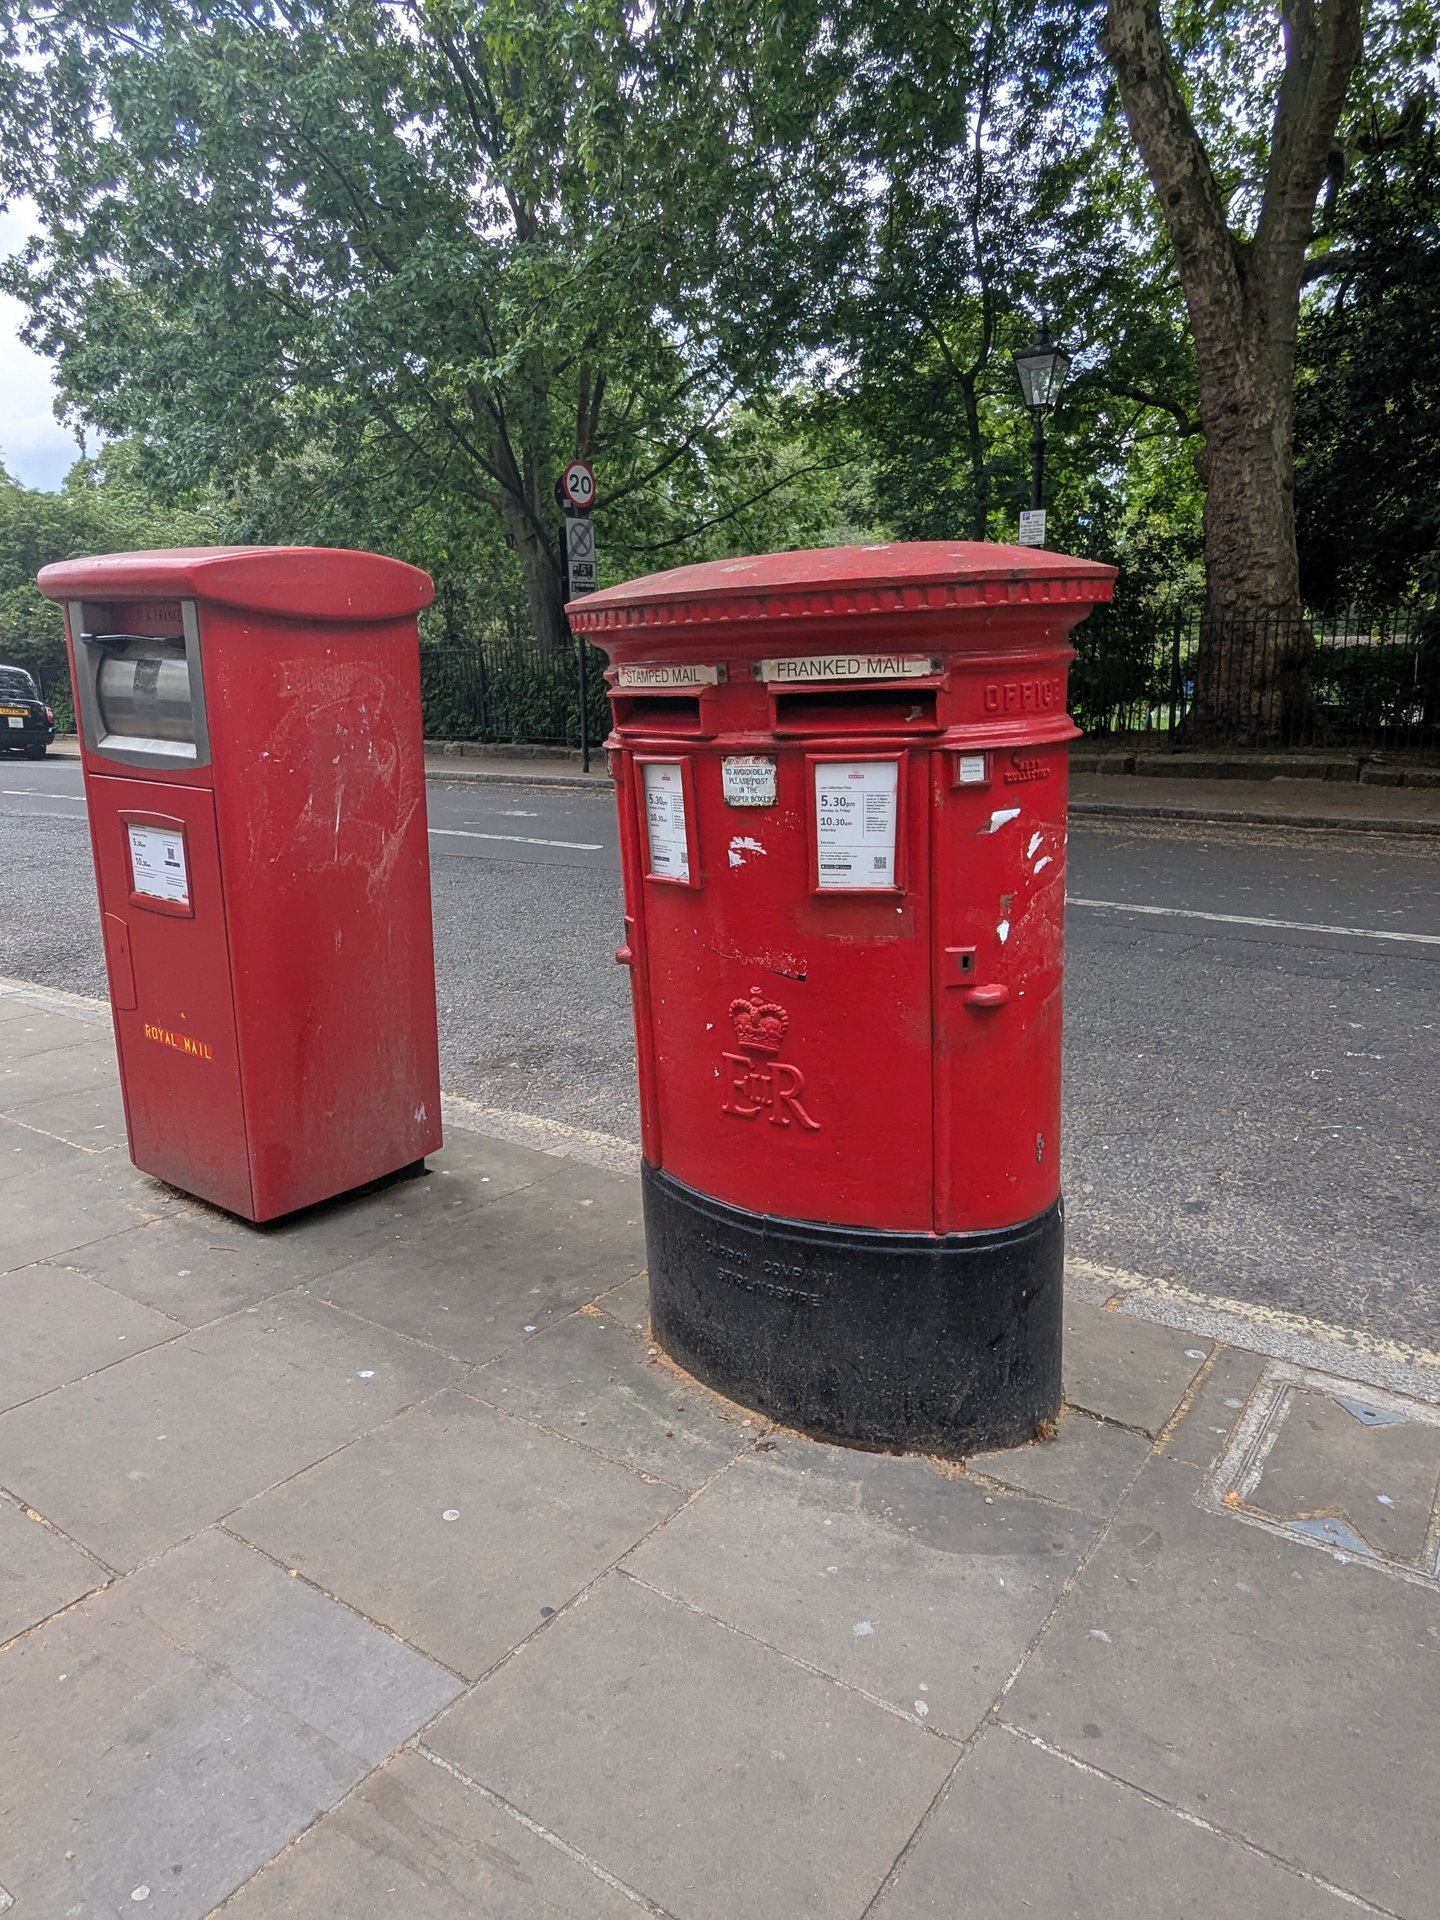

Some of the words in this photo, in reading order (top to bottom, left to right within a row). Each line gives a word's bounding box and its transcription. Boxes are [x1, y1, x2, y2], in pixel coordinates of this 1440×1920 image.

[569, 474, 592, 495] 20
[777, 658, 861, 678] FRANKED
[866, 657, 912, 674] MAIL
[626, 669, 669, 684] STAMPED
[672, 668, 701, 683] MAIL
[733, 768, 751, 776] AVOID
[752, 768, 773, 776] DELAY
[751, 795, 771, 803] BOXES
[821, 794, 856, 808] 5.30pm
[144, 1023, 178, 1047] ROYAL
[183, 1037, 212, 1060] MAIL
